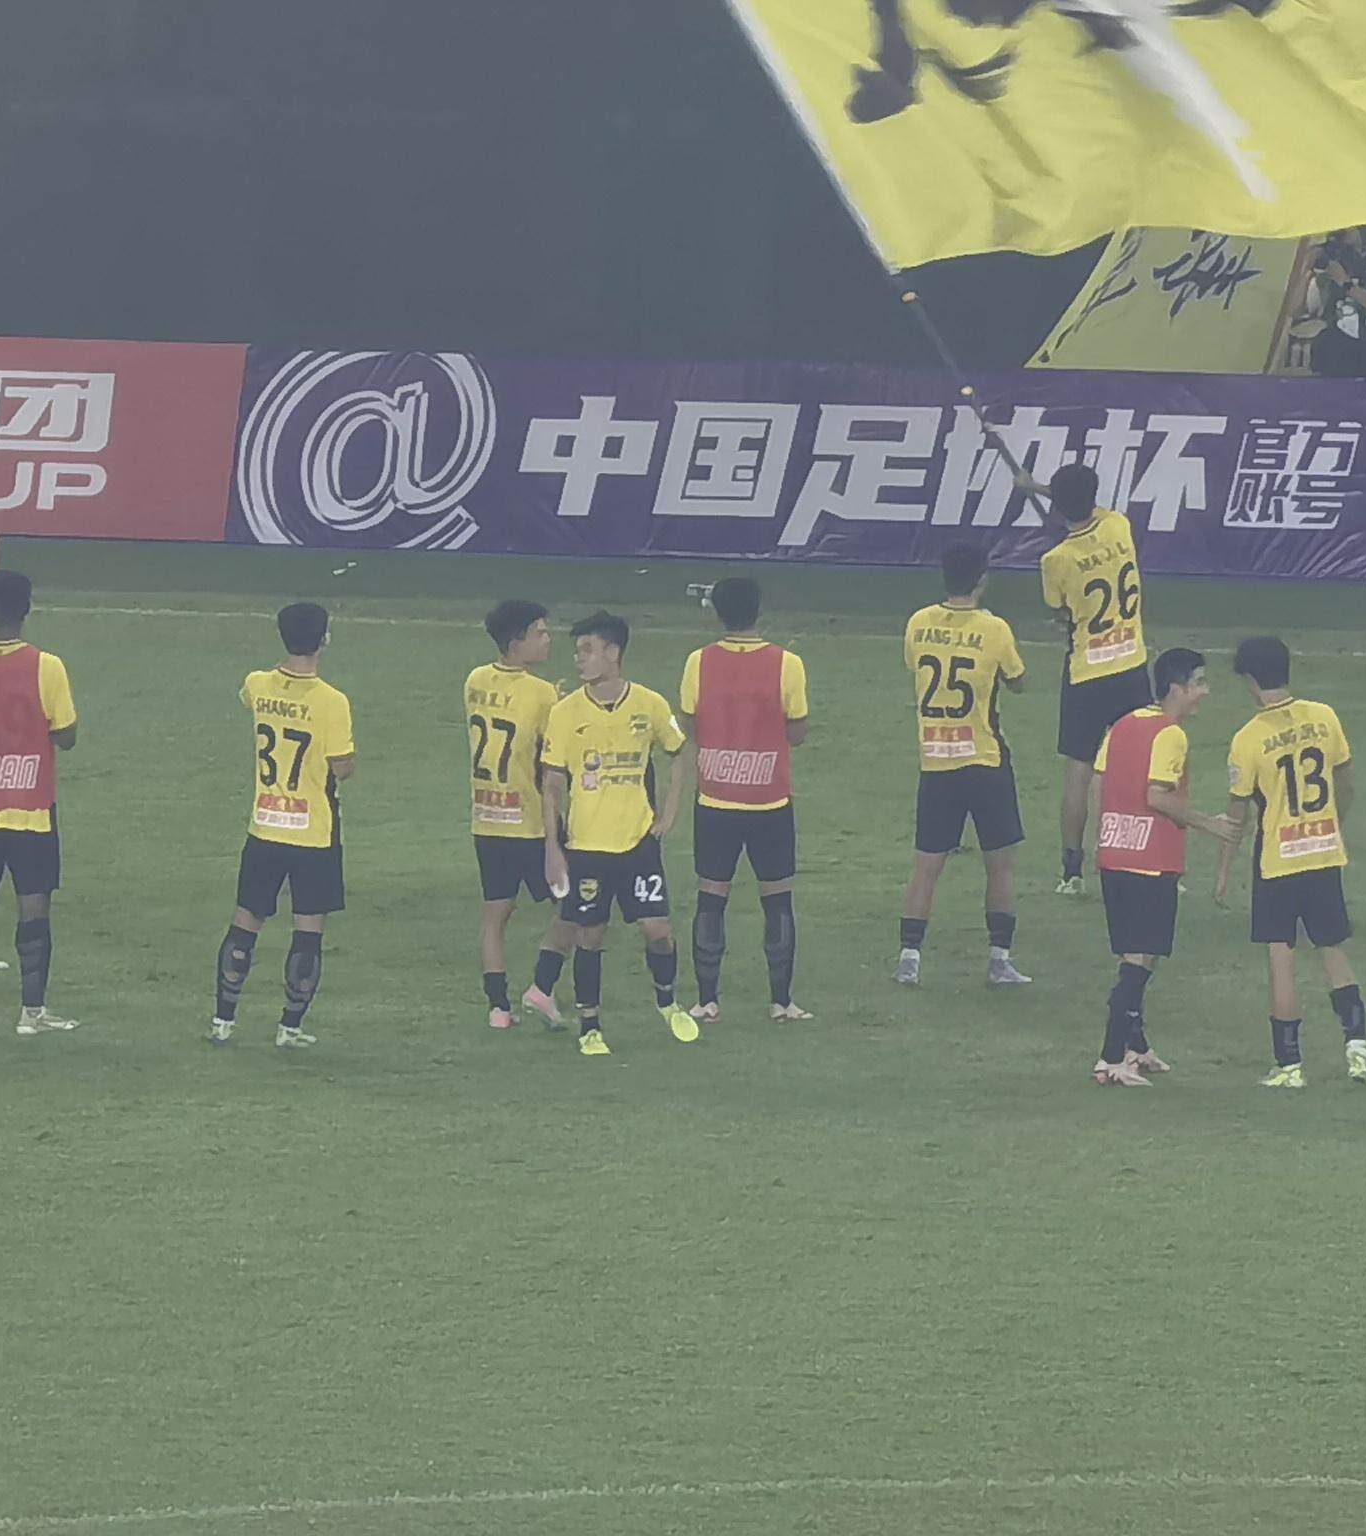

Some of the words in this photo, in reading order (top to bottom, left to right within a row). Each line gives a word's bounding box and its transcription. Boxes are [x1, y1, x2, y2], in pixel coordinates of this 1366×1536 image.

[1084, 561, 1139, 635] 26
[917, 654, 976, 720] 25
[256, 722, 313, 792] 37
[469, 714, 517, 784] 27
[1275, 746, 1330, 818] 13
[634, 874, 664, 902] 42
